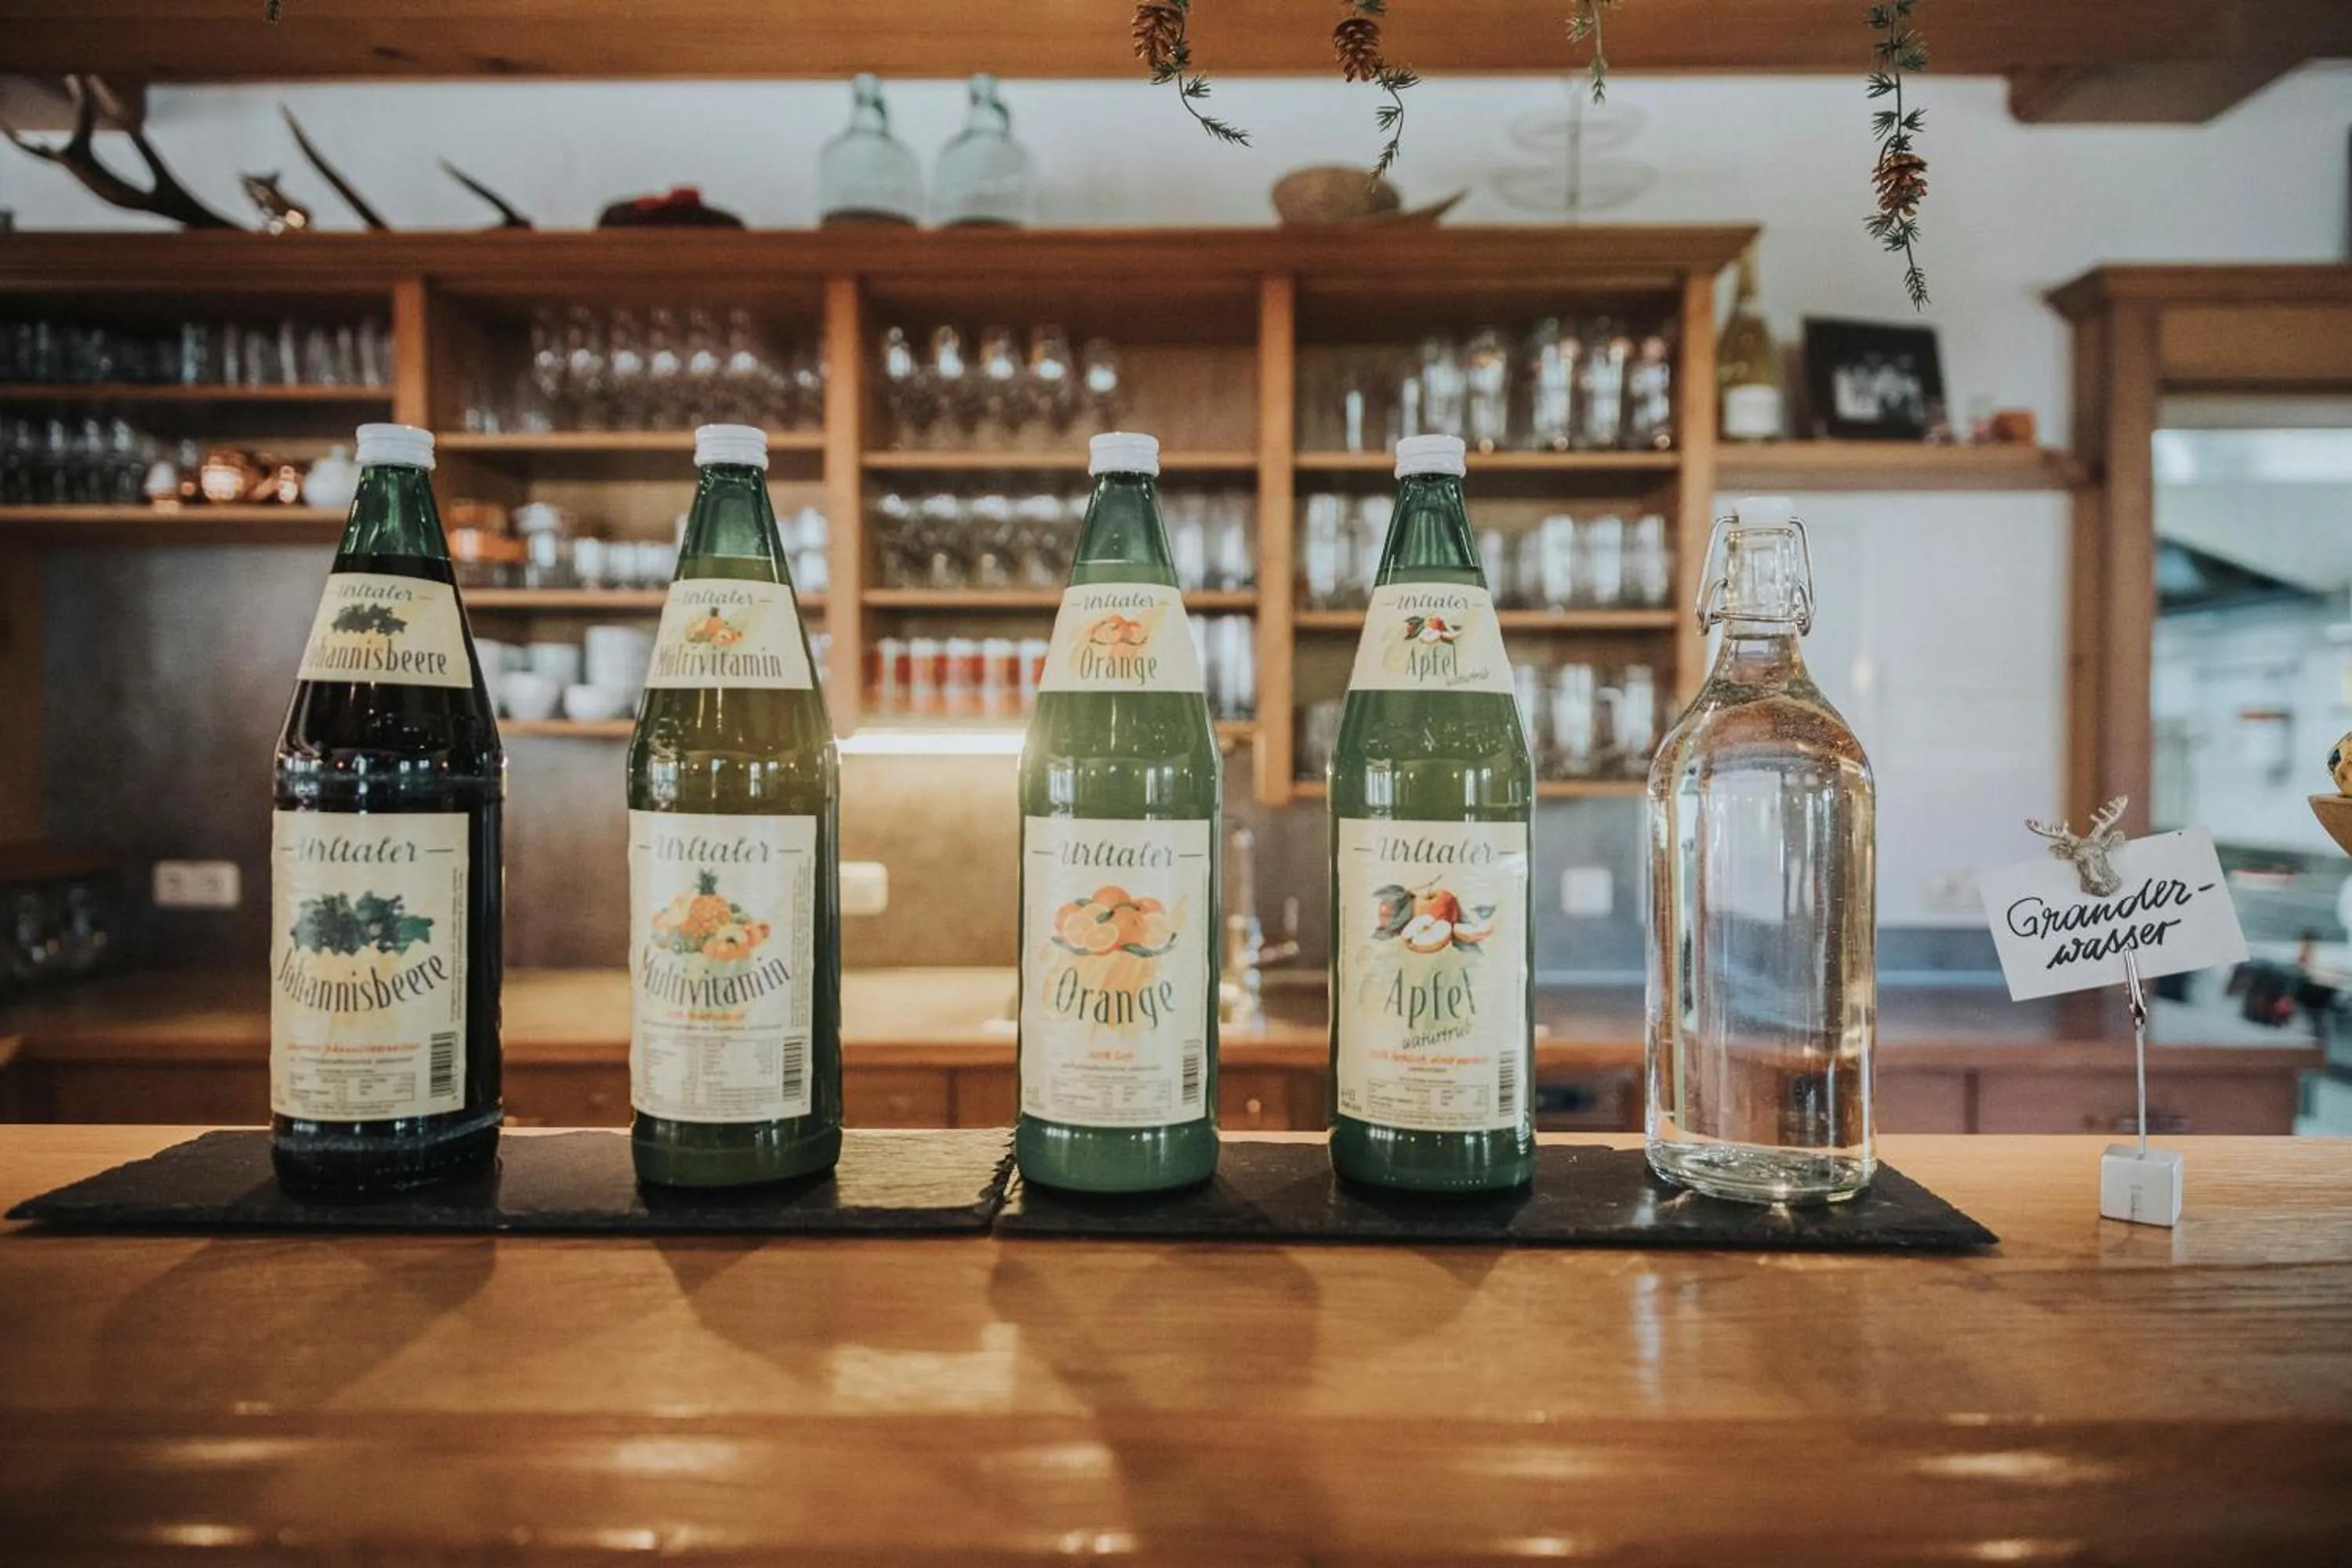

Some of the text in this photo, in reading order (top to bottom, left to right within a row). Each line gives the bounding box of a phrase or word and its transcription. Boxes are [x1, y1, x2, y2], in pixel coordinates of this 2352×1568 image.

[1079, 644, 1158, 684] Orange
[1405, 644, 1458, 682] Apfel
[2006, 877, 2216, 939] Grander-
[2045, 918, 2182, 969] wasser
[1056, 967, 1176, 1029] Orange
[1384, 967, 1477, 1029] Apfel
